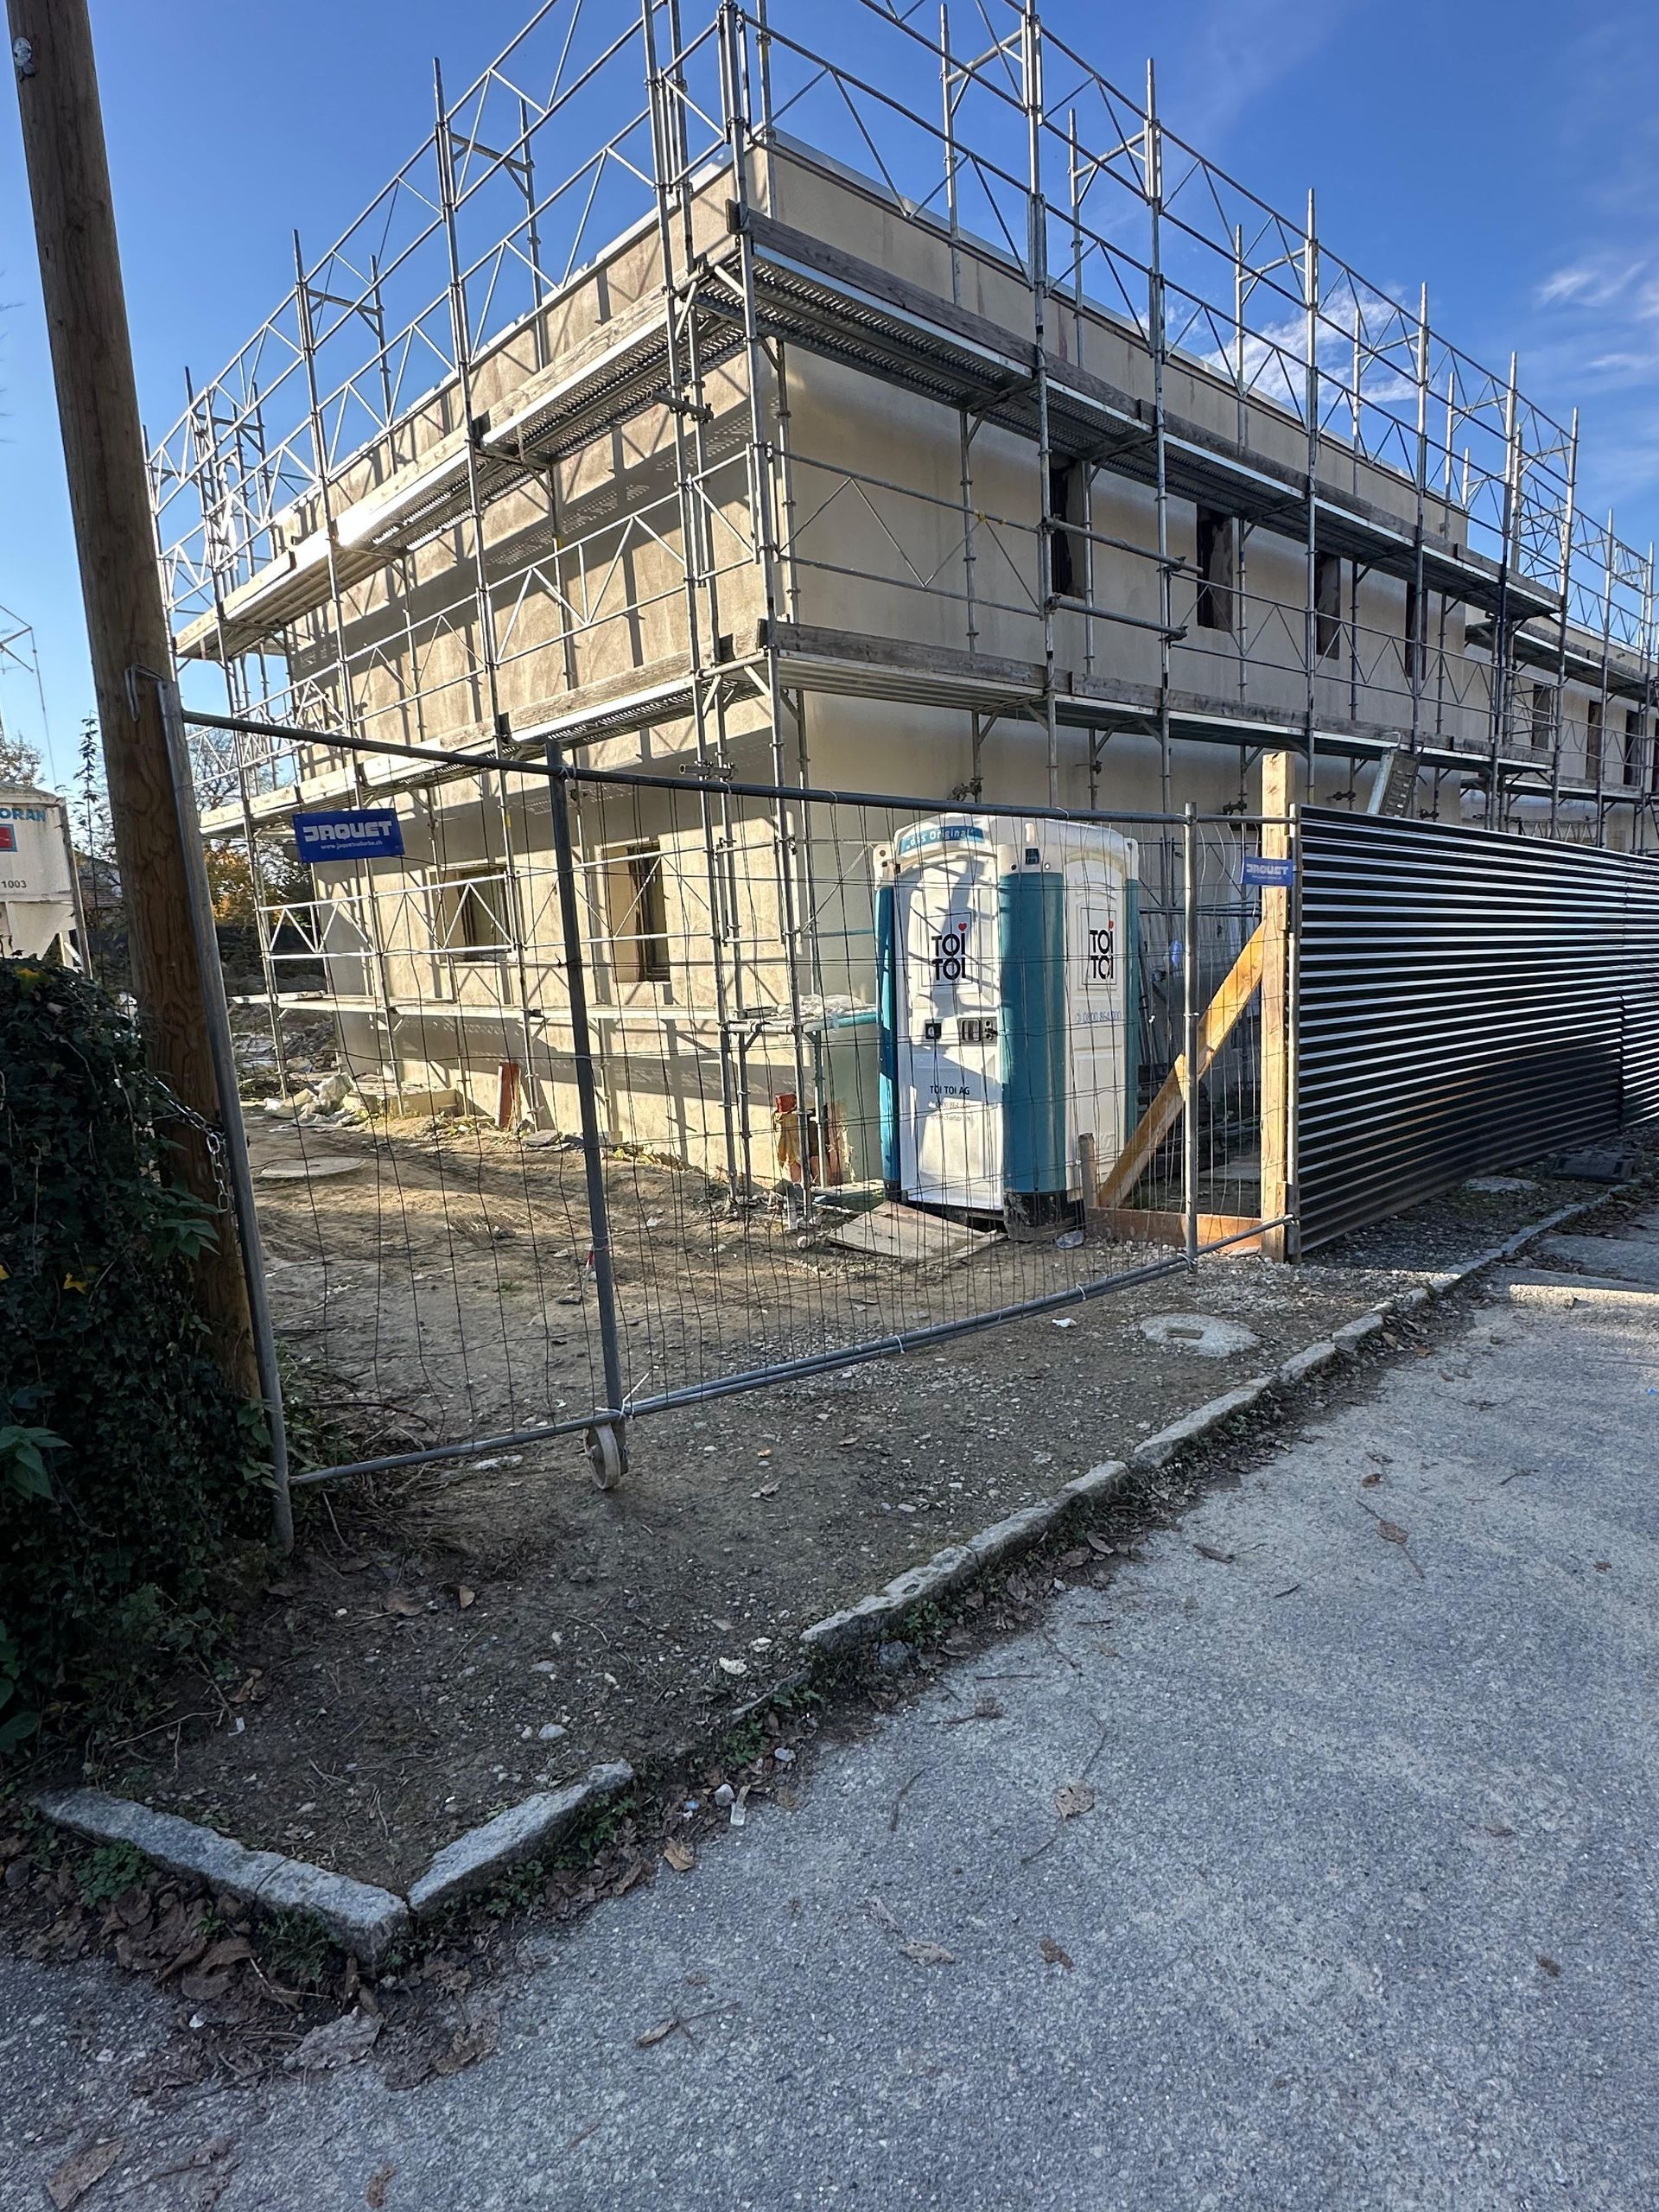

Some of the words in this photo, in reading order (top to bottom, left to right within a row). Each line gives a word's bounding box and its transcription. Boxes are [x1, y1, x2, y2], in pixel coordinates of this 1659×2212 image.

[302, 820, 392, 842] JAQUET
[1, 880, 27, 888] 1003
[931, 957, 966, 981] TOI
[1090, 955, 1114, 979] TOI
[930, 1085, 942, 1094] TOI
[944, 1085, 957, 1095] TOI
[959, 1086, 970, 1095] AG
